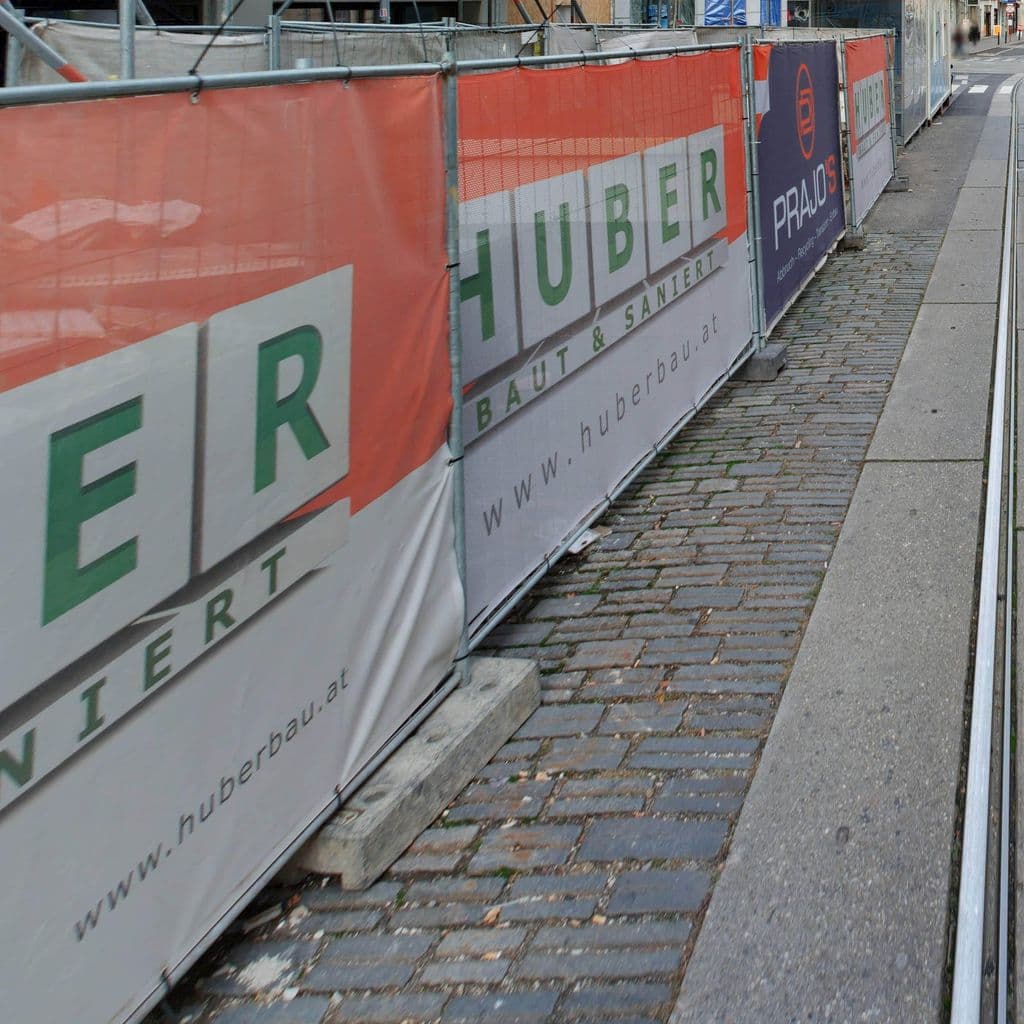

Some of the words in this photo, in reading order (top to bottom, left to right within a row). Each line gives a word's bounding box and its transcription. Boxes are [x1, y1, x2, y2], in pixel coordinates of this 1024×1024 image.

[459, 147, 722, 344] HUBER
[772, 154, 838, 252] PRAJO'S
[475, 346, 569, 434] BAUT
[591, 325, 606, 354] &
[624, 249, 715, 331] SANIERT
[482, 313, 719, 537] www.huberbau.at
[72, 666, 350, 943] www.huberbau.at
